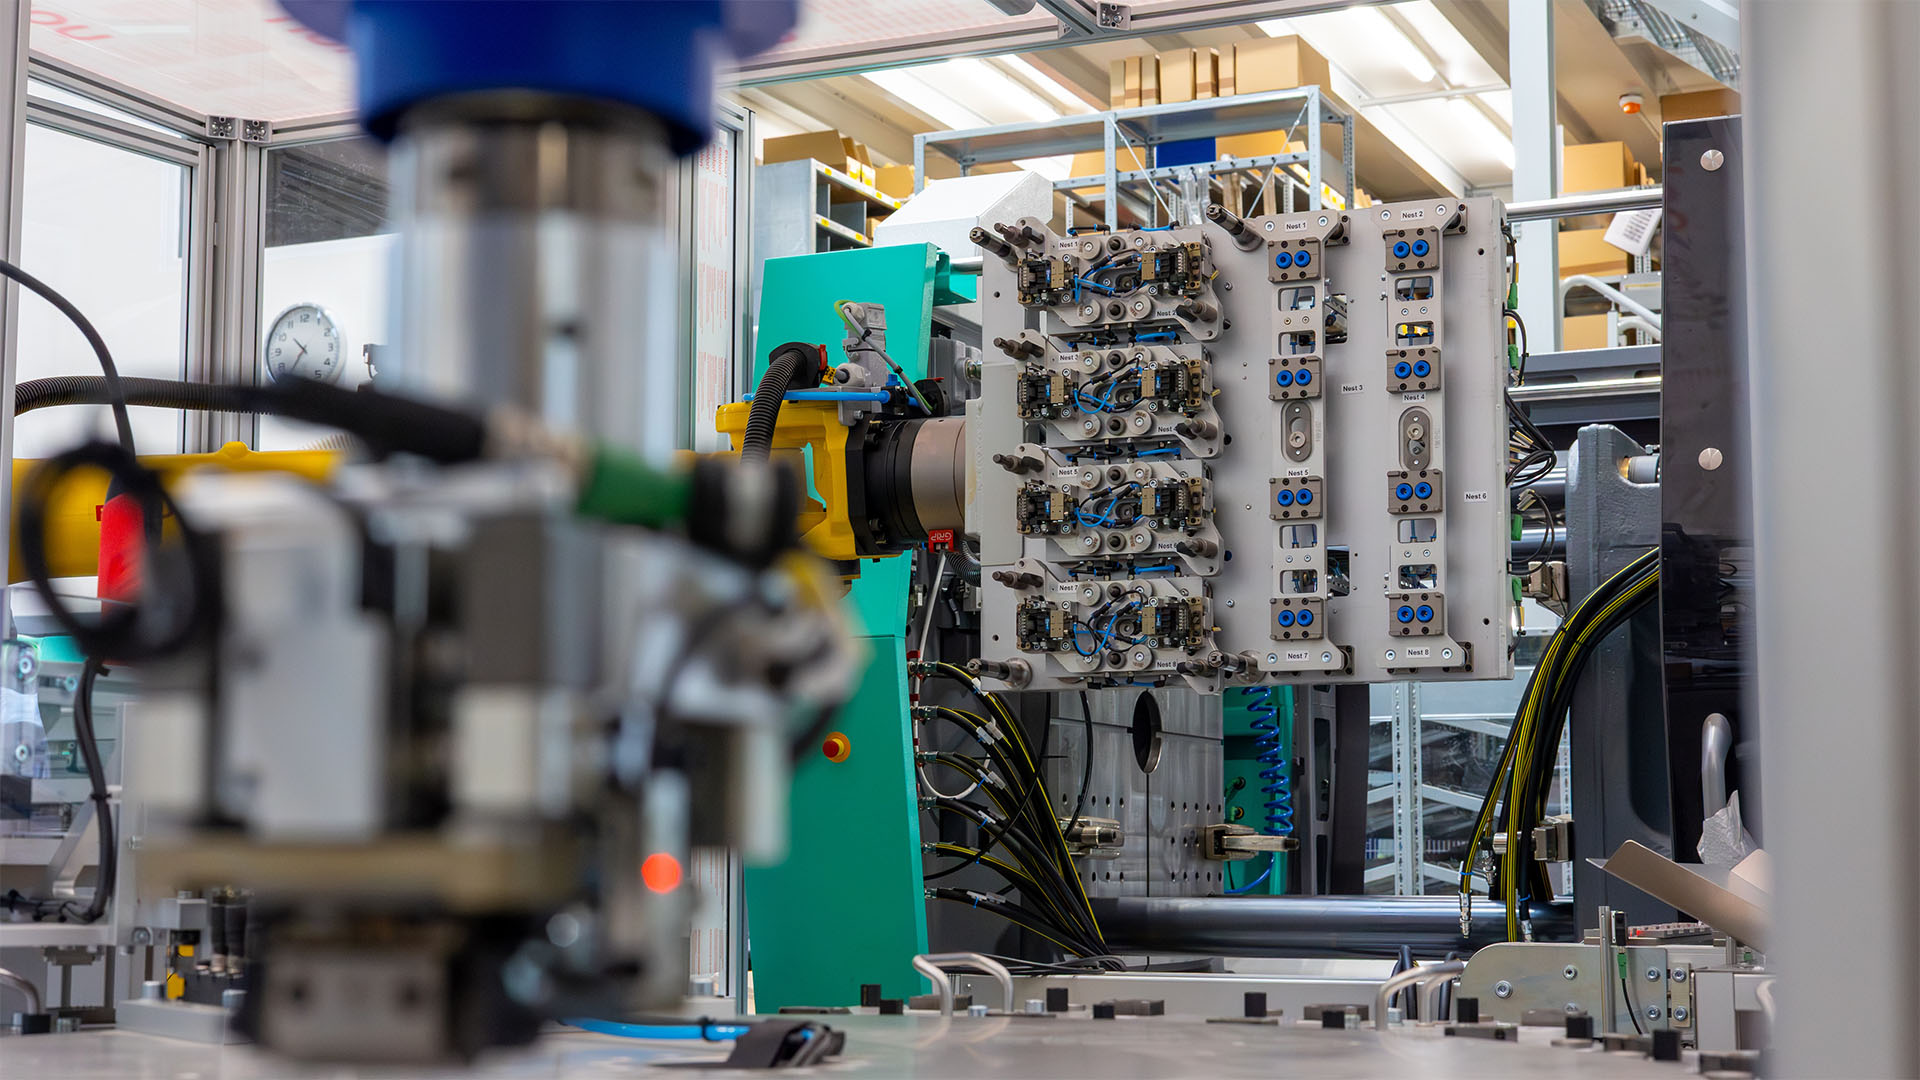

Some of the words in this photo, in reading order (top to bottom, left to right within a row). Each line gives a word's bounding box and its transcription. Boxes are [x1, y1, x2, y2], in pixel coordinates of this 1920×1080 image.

[300, 314, 310, 323] 12
[288, 320, 294, 328] 11
[324, 328, 331, 337] 2
[328, 343, 334, 352] 3
[275, 348, 282, 357] 9
[930, 532, 952, 541] GRIP
